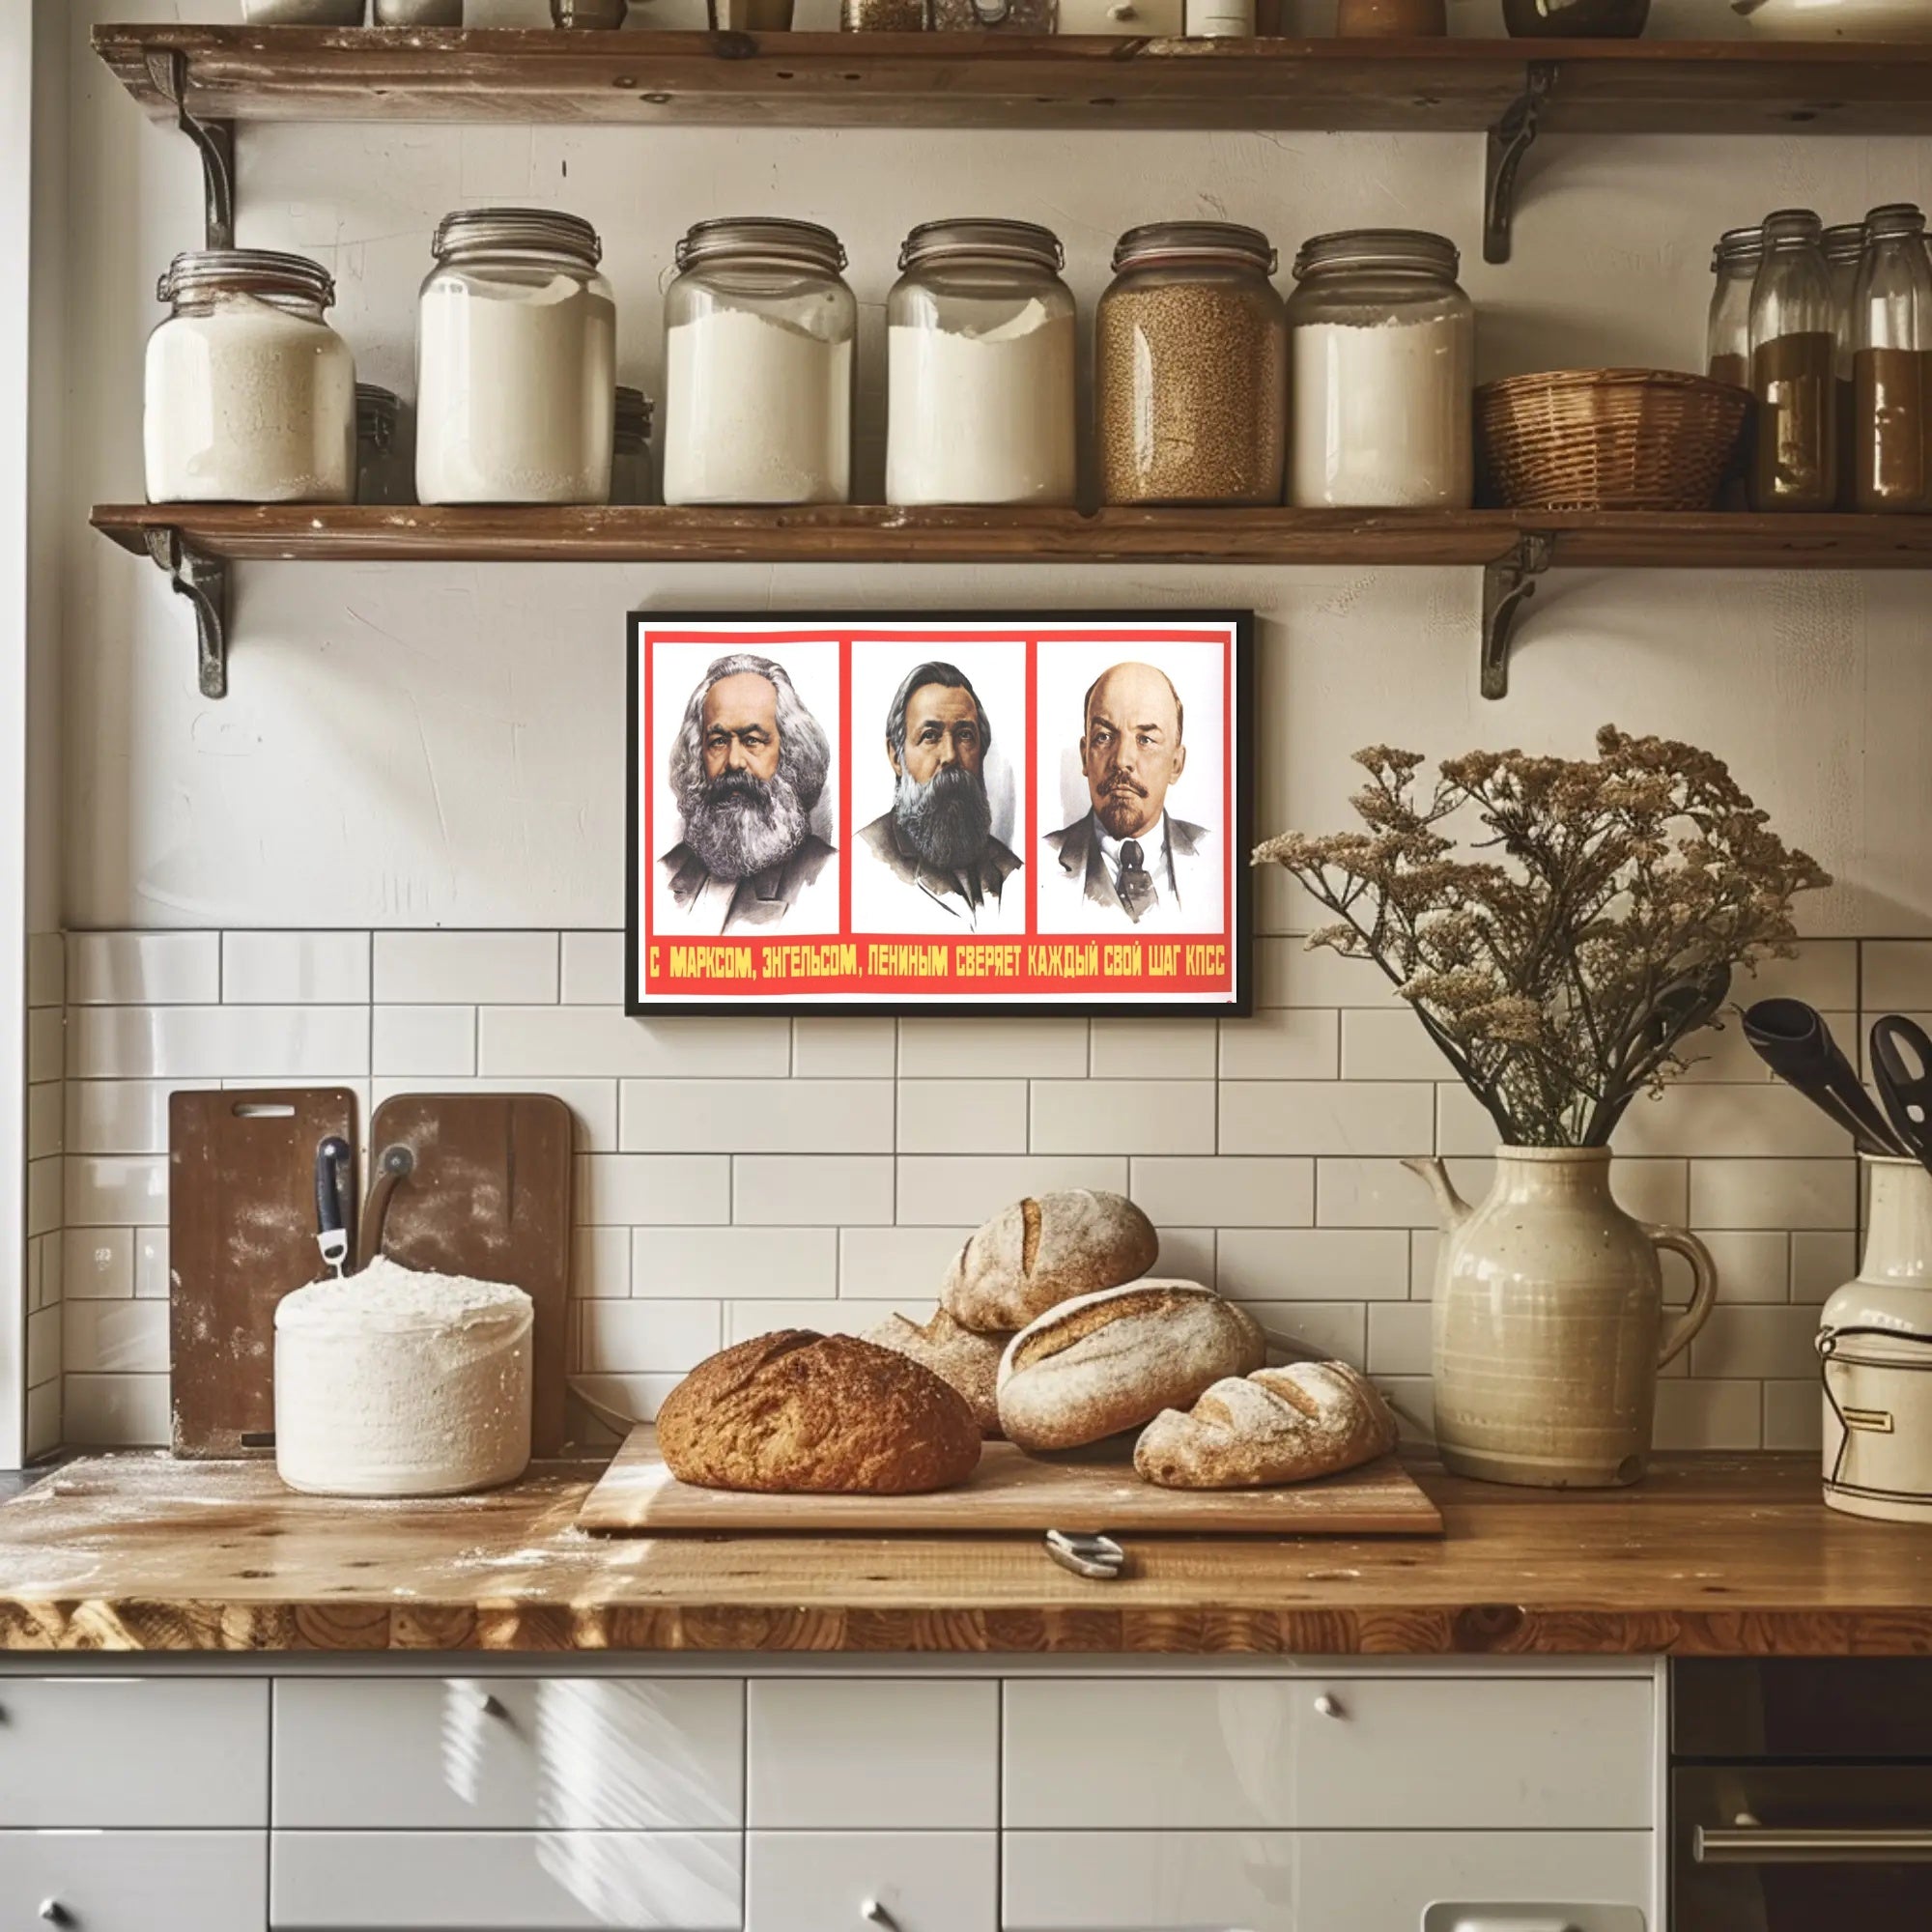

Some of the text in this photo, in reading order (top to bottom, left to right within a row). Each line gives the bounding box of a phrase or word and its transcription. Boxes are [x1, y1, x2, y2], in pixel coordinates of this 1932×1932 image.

[649, 940, 1225, 981] С МАРКСОМ, ЭНГЕЛЬСОМ, ЛЕНИНЫМ СВЕРЯЕТ КАЖДЫЙ СВОЙ ШАГ КПСС
